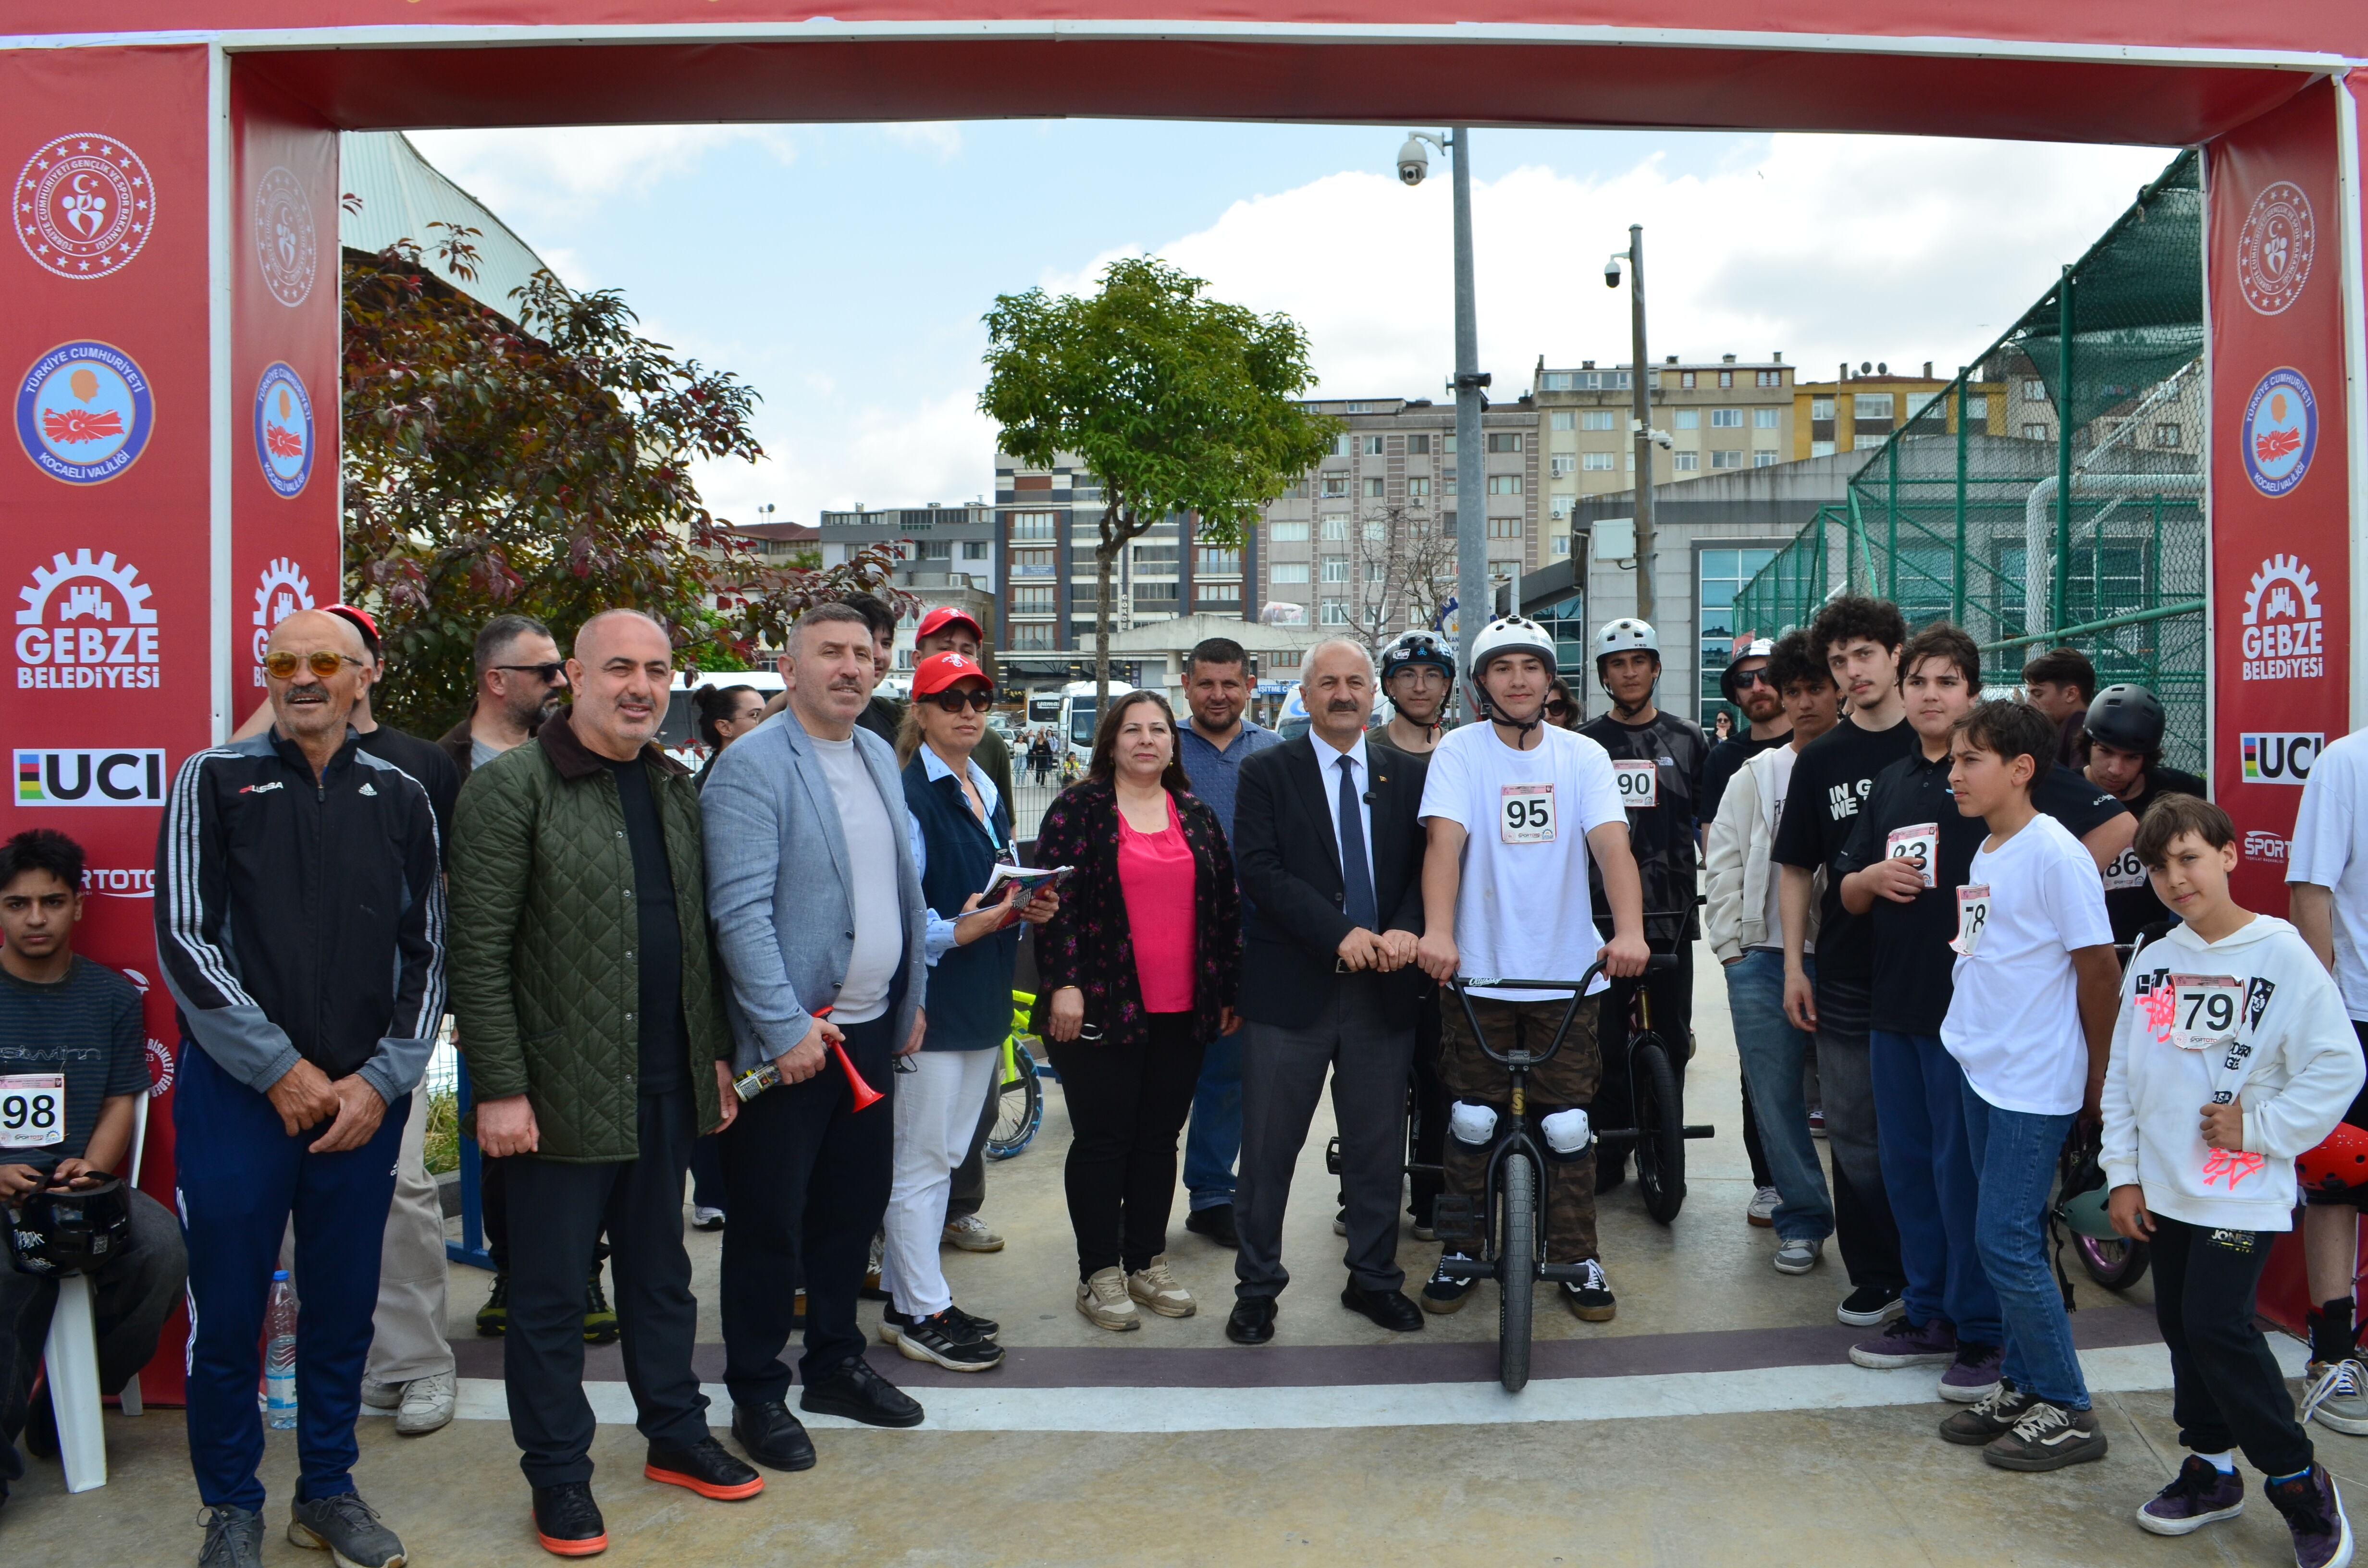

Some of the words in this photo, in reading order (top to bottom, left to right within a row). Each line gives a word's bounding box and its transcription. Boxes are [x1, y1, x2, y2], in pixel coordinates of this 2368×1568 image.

[109, 170, 121, 183] VE
[117, 182, 130, 206] SPOR
[25, 351, 69, 393] TÜRKİYE
[70, 347, 146, 393] CUMHURİYETİ
[2246, 381, 2270, 422] TÜRKİYE
[2269, 373, 2314, 408] CUMHURİYETİ
[38, 452, 86, 479] KOCAELİ
[86, 449, 131, 478] VALİLİĞİ
[2254, 472, 2280, 492] KOCAELİ
[2280, 461, 2306, 490] VALİLİĞİ
[16, 627, 159, 664] GEBZE
[2243, 621, 2323, 659] GEBZE
[46, 753, 160, 800] UCI
[1617, 773, 1650, 795] 90
[1829, 783, 1849, 804] IN
[1830, 797, 1859, 821] WE
[1507, 799, 1549, 829] 95
[2244, 837, 2293, 858] SPORT
[2106, 852, 2141, 878] 86
[1965, 904, 1986, 939] 78
[1468, 977, 1503, 987] Odyssey
[2183, 993, 2233, 1031] 79
[147, 1038, 174, 1074] BİSİKLET
[3, 1094, 56, 1129] 98
[2211, 1229, 2255, 1246] JONES
